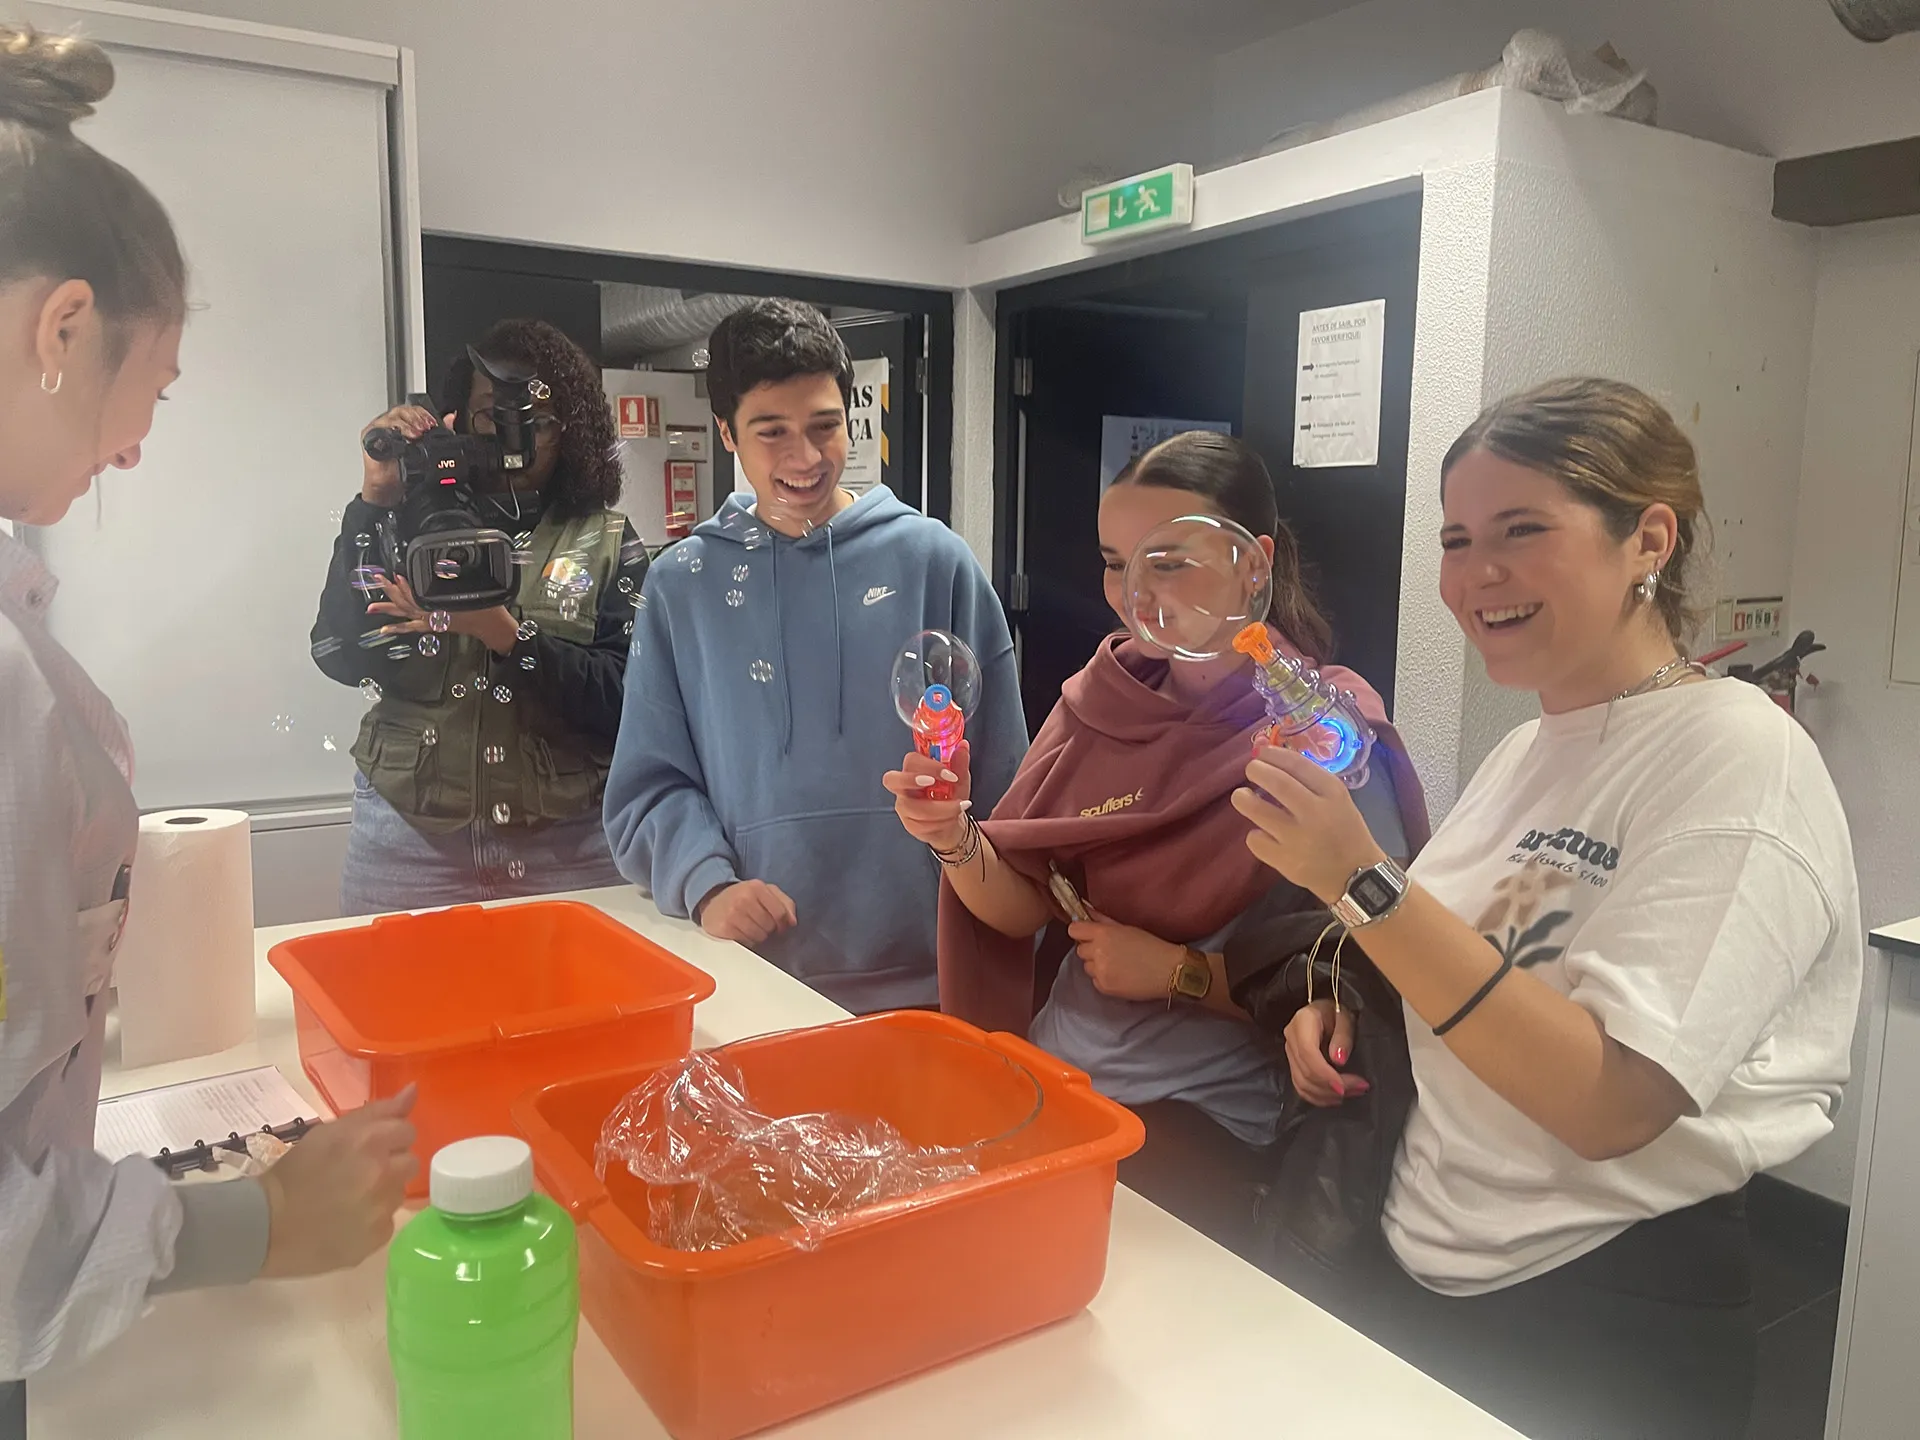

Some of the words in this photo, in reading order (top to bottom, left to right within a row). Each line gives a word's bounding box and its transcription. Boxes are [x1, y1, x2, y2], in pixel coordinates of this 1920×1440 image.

[1311, 334, 1329, 344] FAVOR
[851, 385, 873, 408] AS
[848, 418, 873, 447] ÇA
[437, 459, 456, 469] JVC
[867, 586, 888, 599] NIKE
[1080, 794, 1133, 818] scuffers
